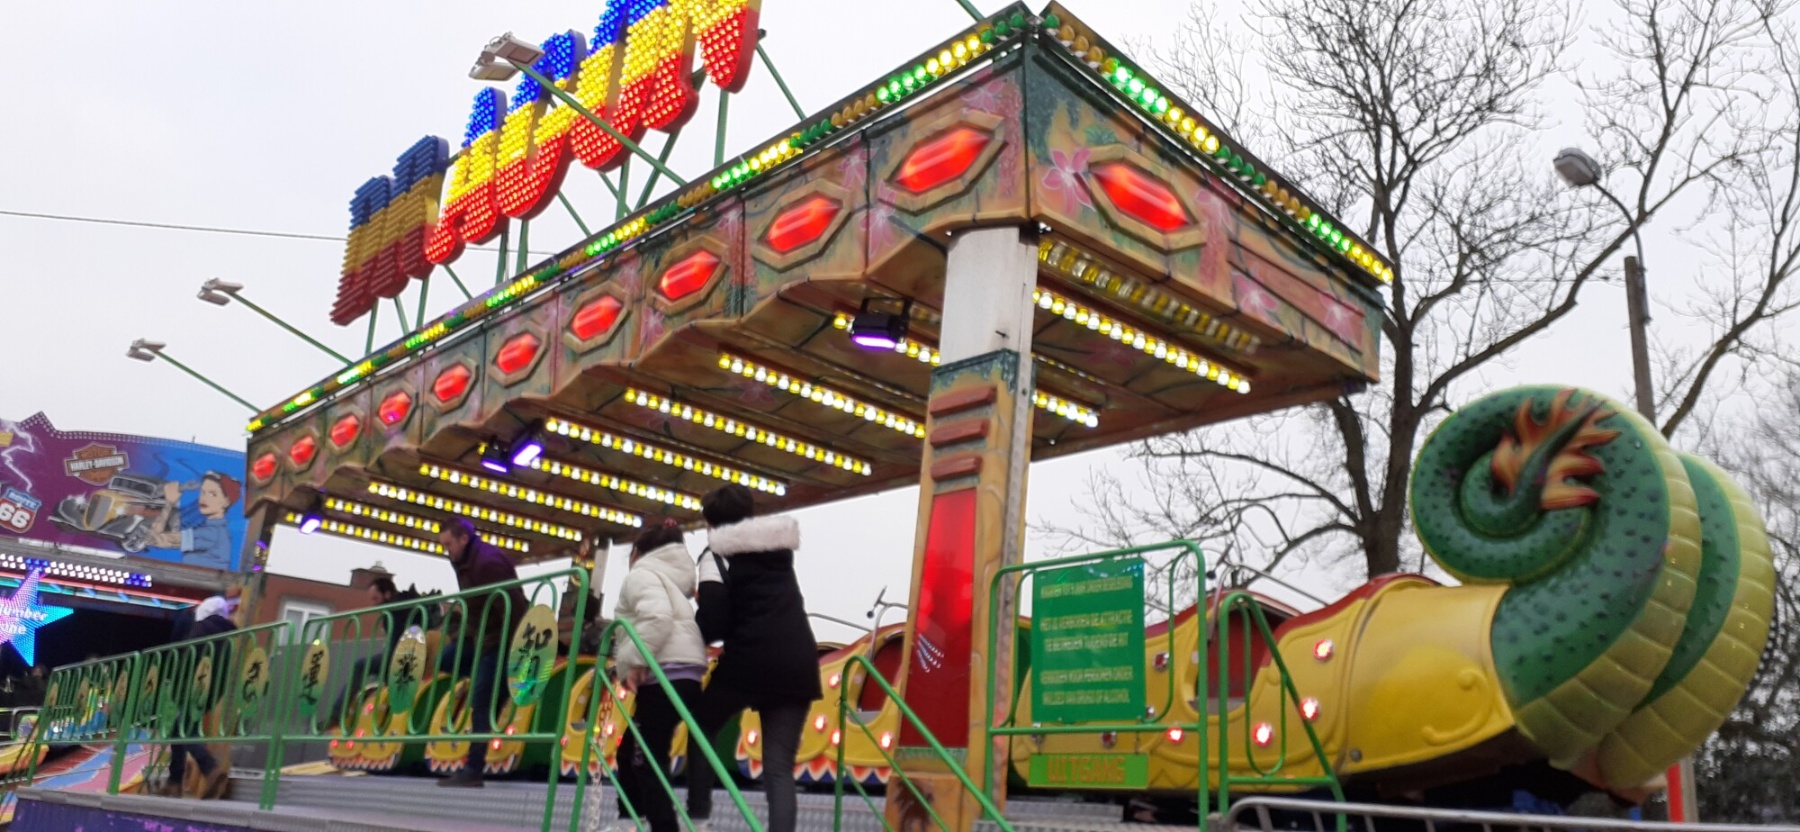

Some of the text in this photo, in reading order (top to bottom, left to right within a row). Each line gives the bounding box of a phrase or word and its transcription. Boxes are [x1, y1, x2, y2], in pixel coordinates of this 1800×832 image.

[8, 491, 37, 509] ROUTE
[0, 502, 31, 529] 66
[0, 604, 48, 621] umber
[1047, 757, 1125, 784] UITGANG
